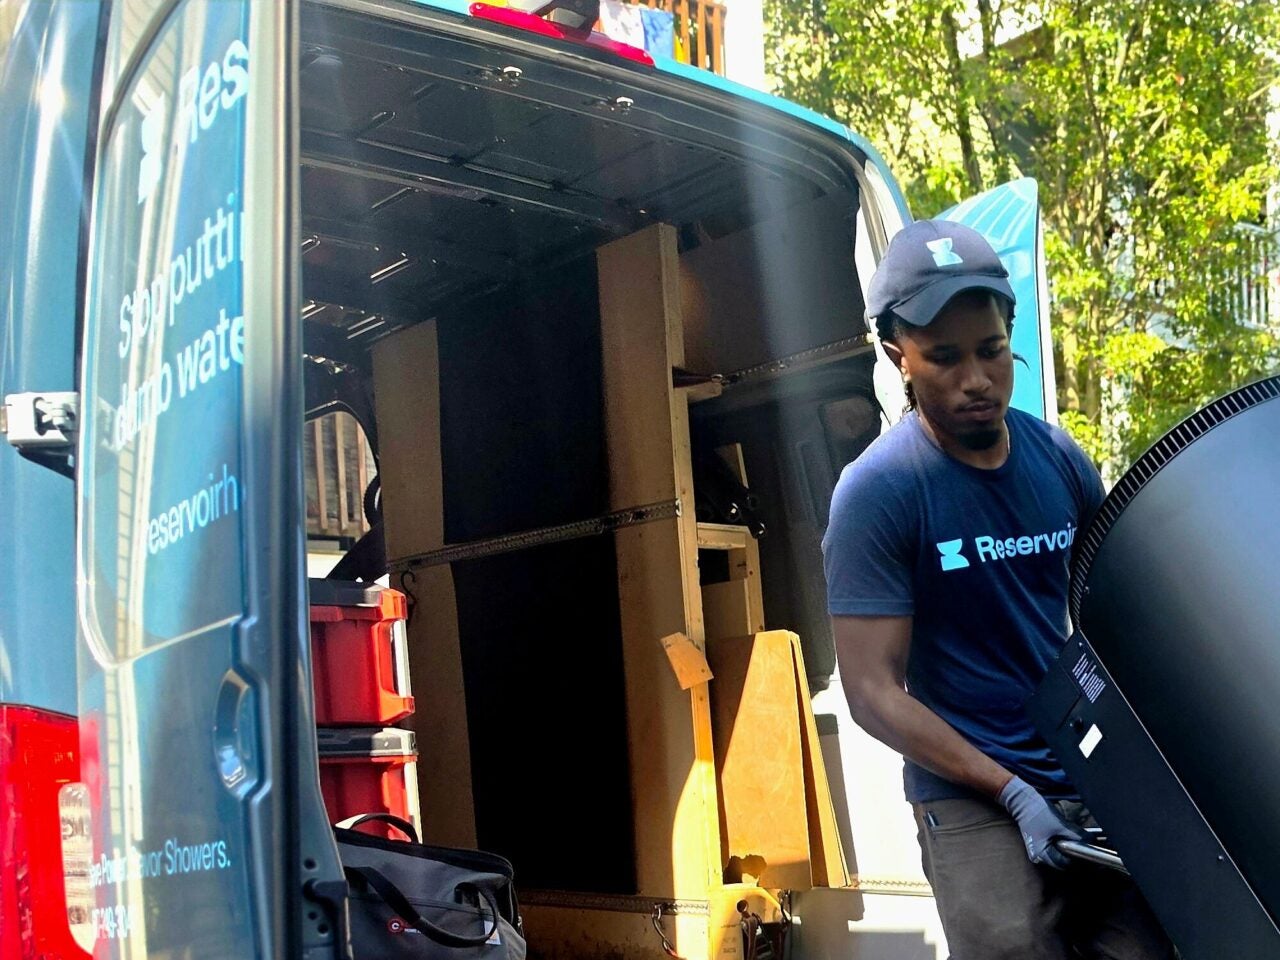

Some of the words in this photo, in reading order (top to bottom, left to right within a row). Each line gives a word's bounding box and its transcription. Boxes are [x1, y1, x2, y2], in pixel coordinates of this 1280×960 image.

[119, 273, 168, 359] Stop
[145, 463, 238, 555] eservoirh
[975, 521, 1077, 562] Reservoir
[165, 838, 231, 876] Showers.
